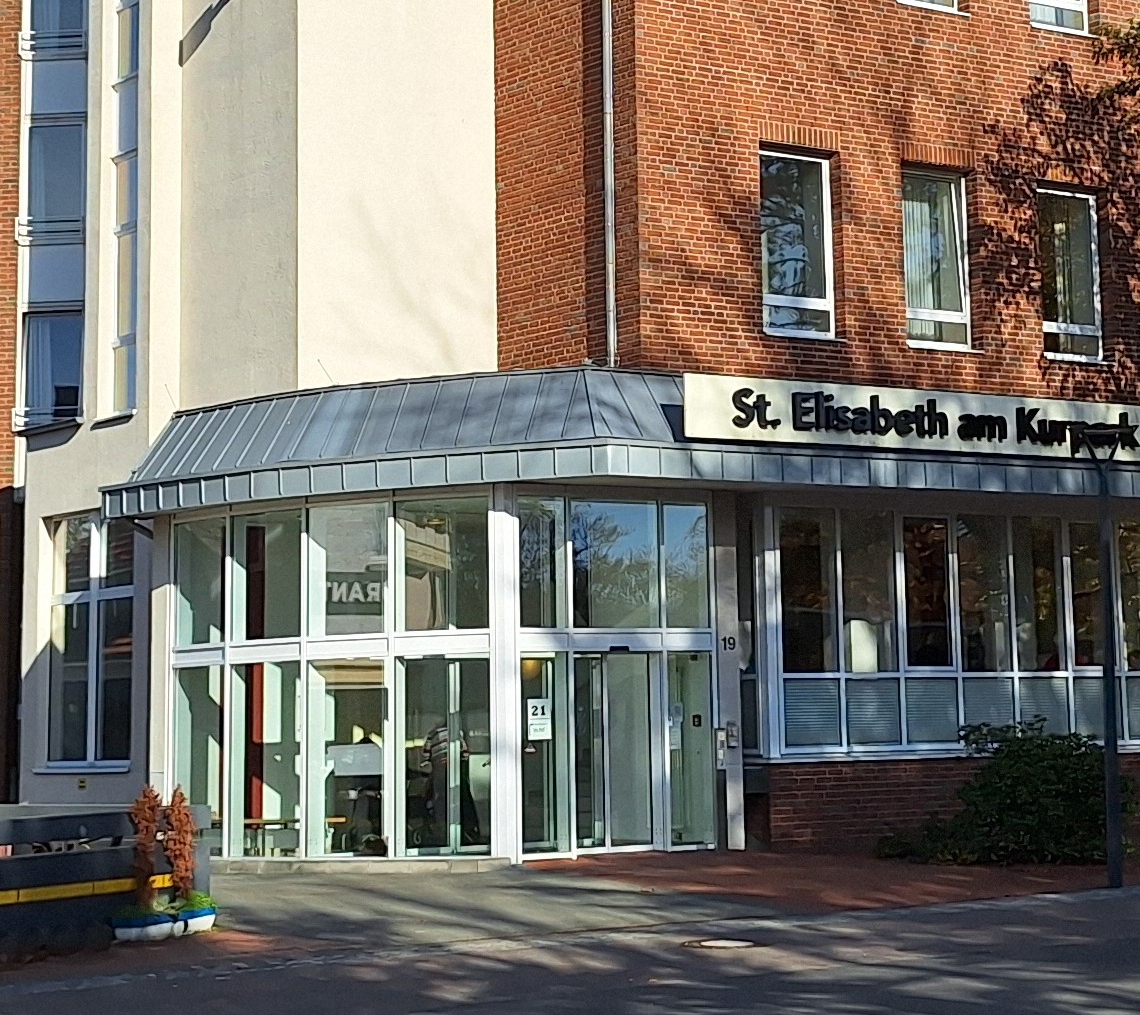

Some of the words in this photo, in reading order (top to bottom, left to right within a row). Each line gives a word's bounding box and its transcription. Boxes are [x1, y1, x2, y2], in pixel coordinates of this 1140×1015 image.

[732, 388, 781, 430] St.
[792, 391, 949, 438] Elisabeth
[957, 413, 1008, 443] am
[721, 636, 736, 651] 19
[531, 705, 546, 716] 21
